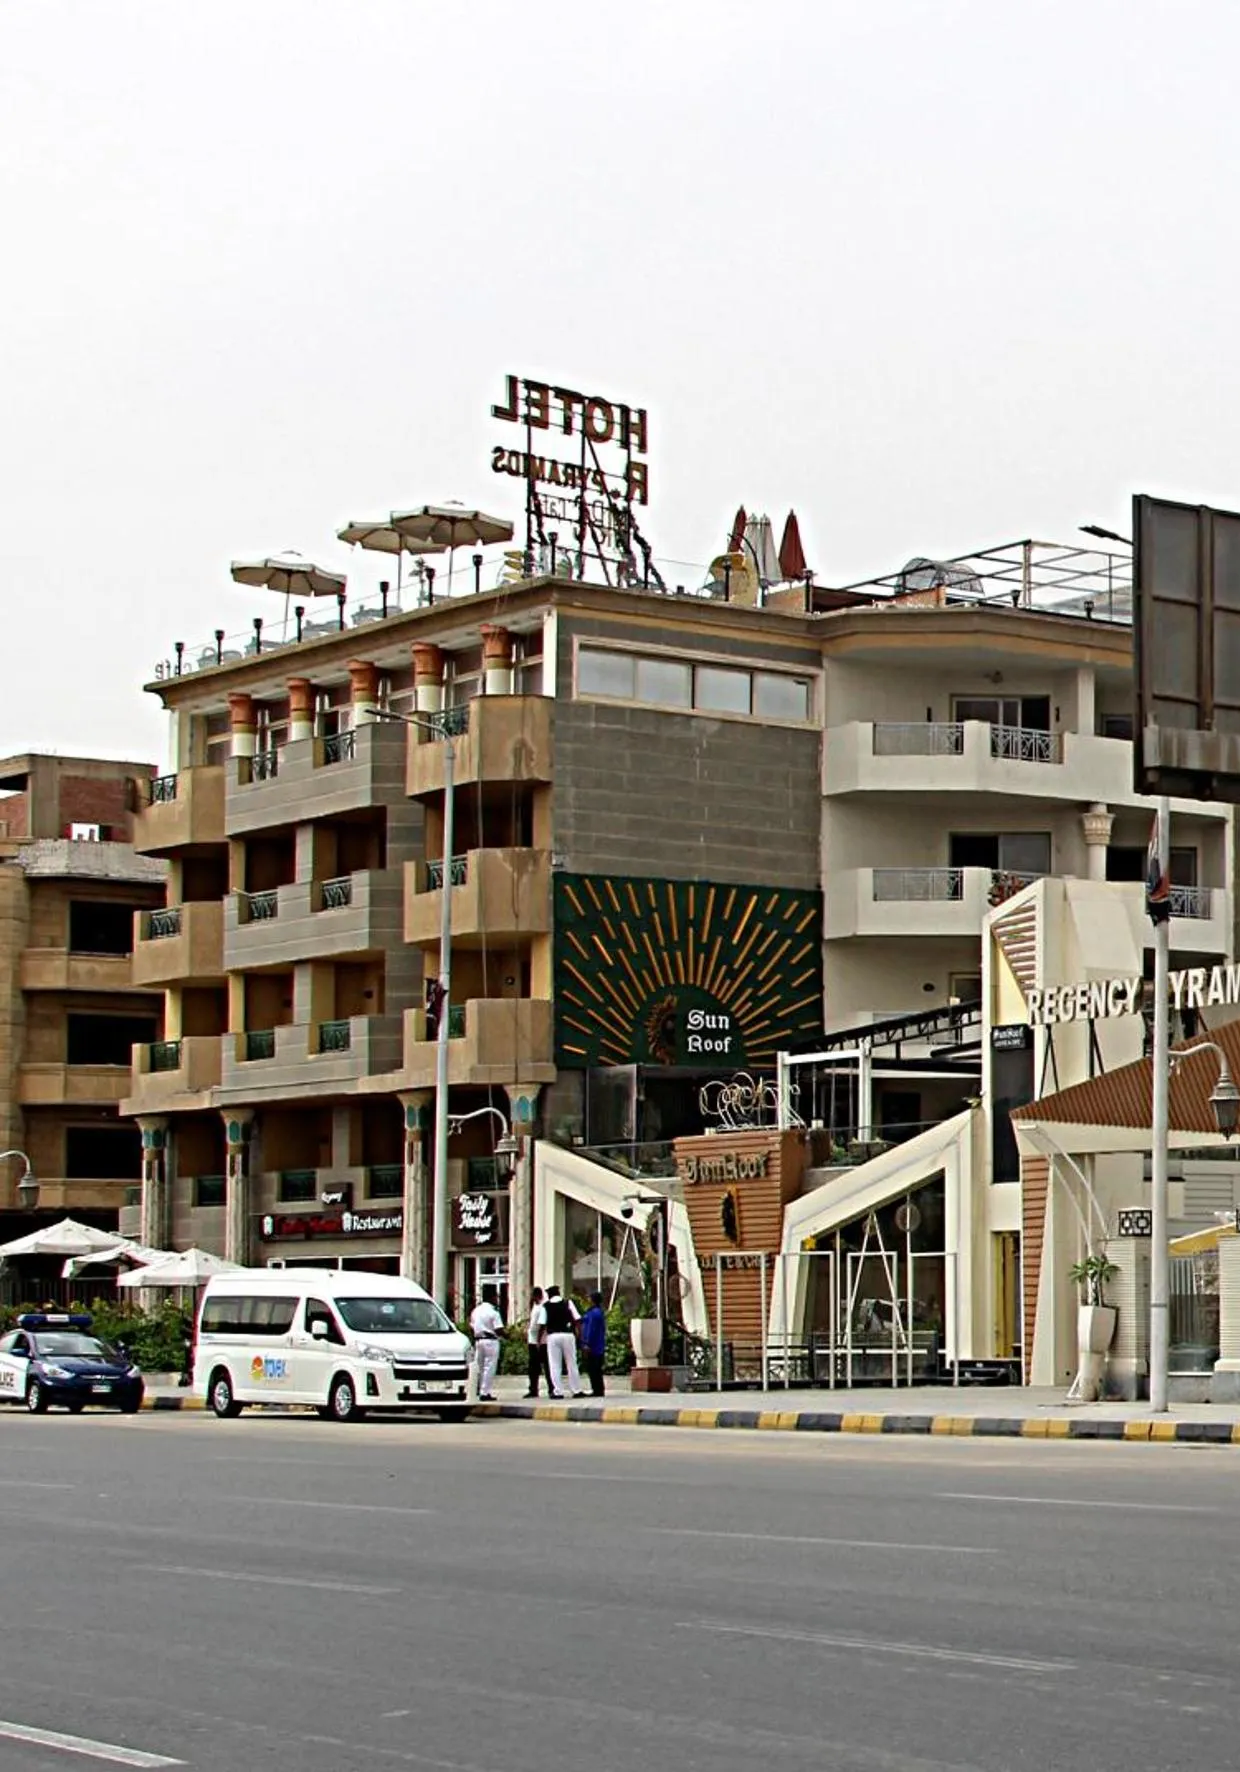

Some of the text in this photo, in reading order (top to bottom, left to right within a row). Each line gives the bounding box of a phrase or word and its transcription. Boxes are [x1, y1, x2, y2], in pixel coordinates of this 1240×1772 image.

[1027, 976, 1142, 1025] REGENCY
[687, 1009, 730, 1030] Sun
[687, 1035, 733, 1054] Roof
